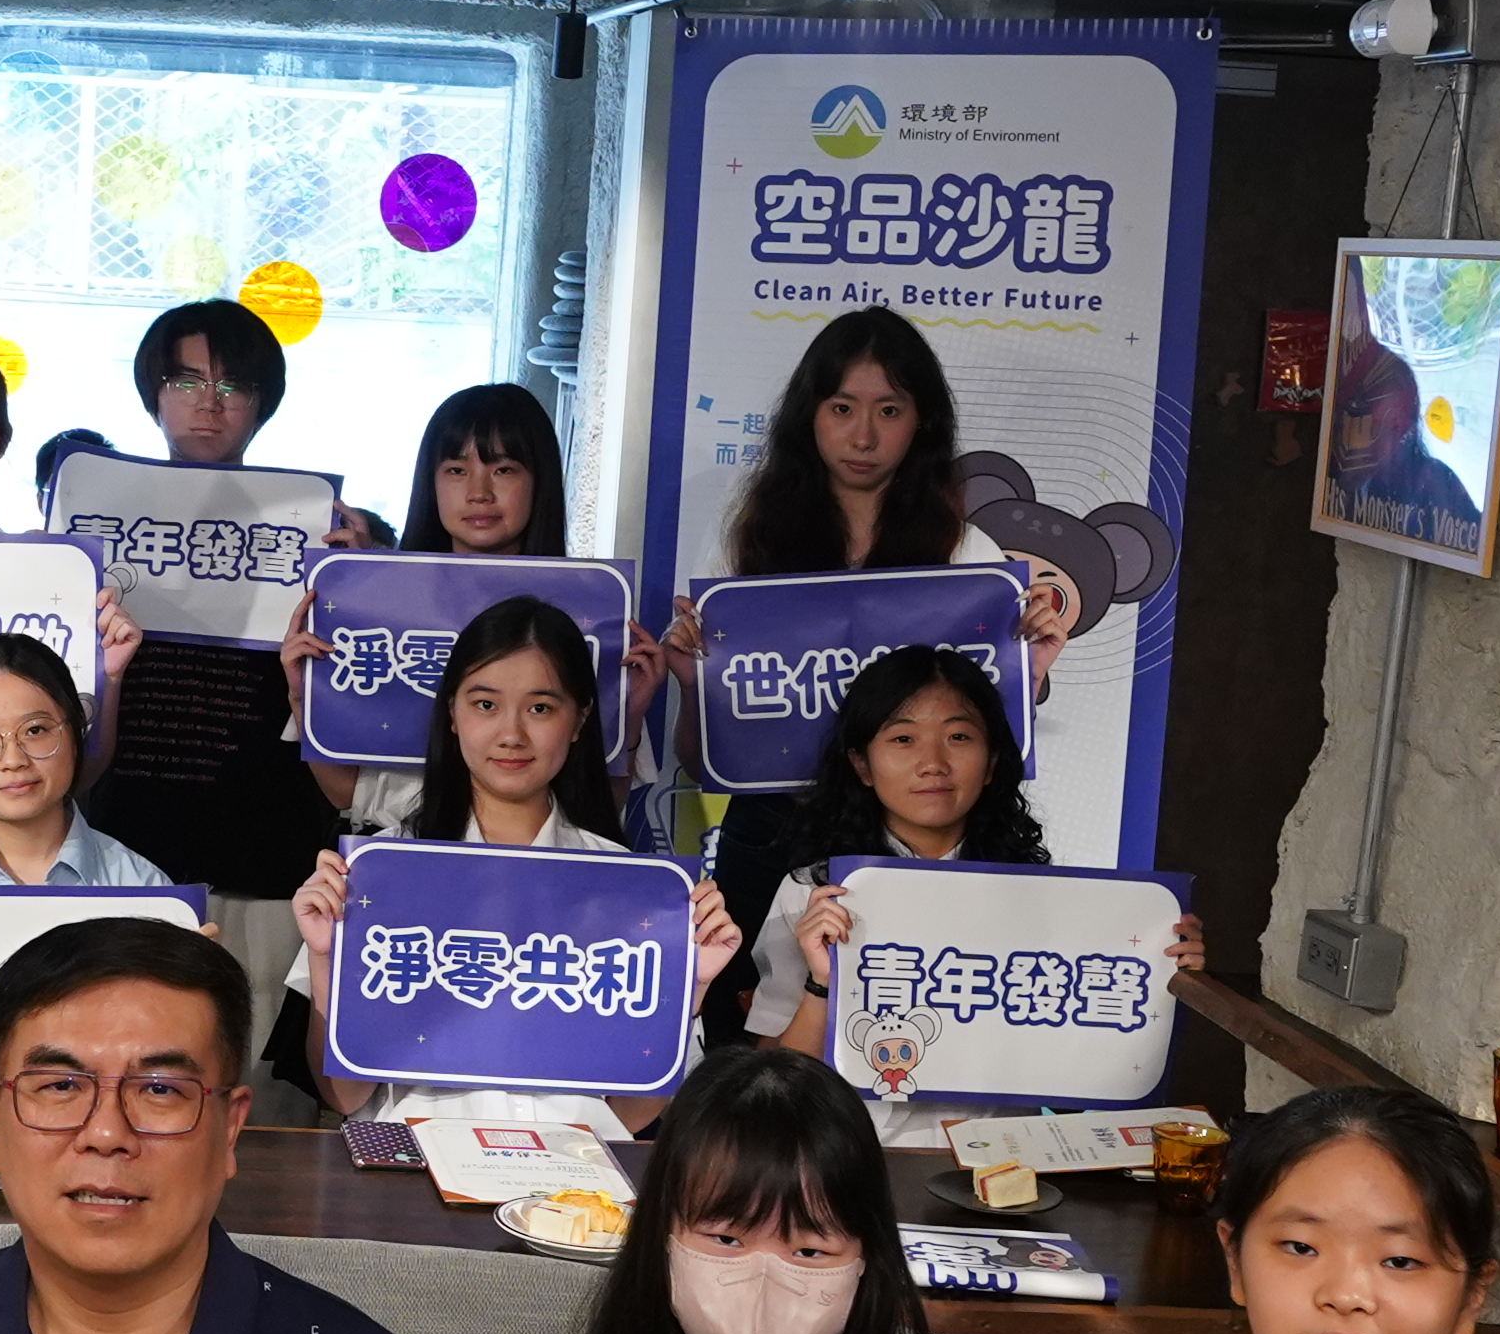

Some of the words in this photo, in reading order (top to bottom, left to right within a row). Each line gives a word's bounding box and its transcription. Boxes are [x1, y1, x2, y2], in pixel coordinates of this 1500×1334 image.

[899, 128, 951, 144] Ministry
[955, 128, 970, 142] of
[973, 129, 1060, 144] Environment
[900, 102, 988, 124] 環境部
[751, 170, 1114, 274] 空品沙龍
[753, 279, 832, 303] Clean
[842, 280, 891, 309] Air,
[901, 283, 994, 308] Better
[1004, 286, 1104, 312] Future
[1324, 476, 1347, 522] His
[1353, 487, 1425, 539] Monster's
[1432, 506, 1480, 553] Voice
[360, 924, 662, 1018] 淨零共利
[857, 943, 1148, 1033] 青年發聲
